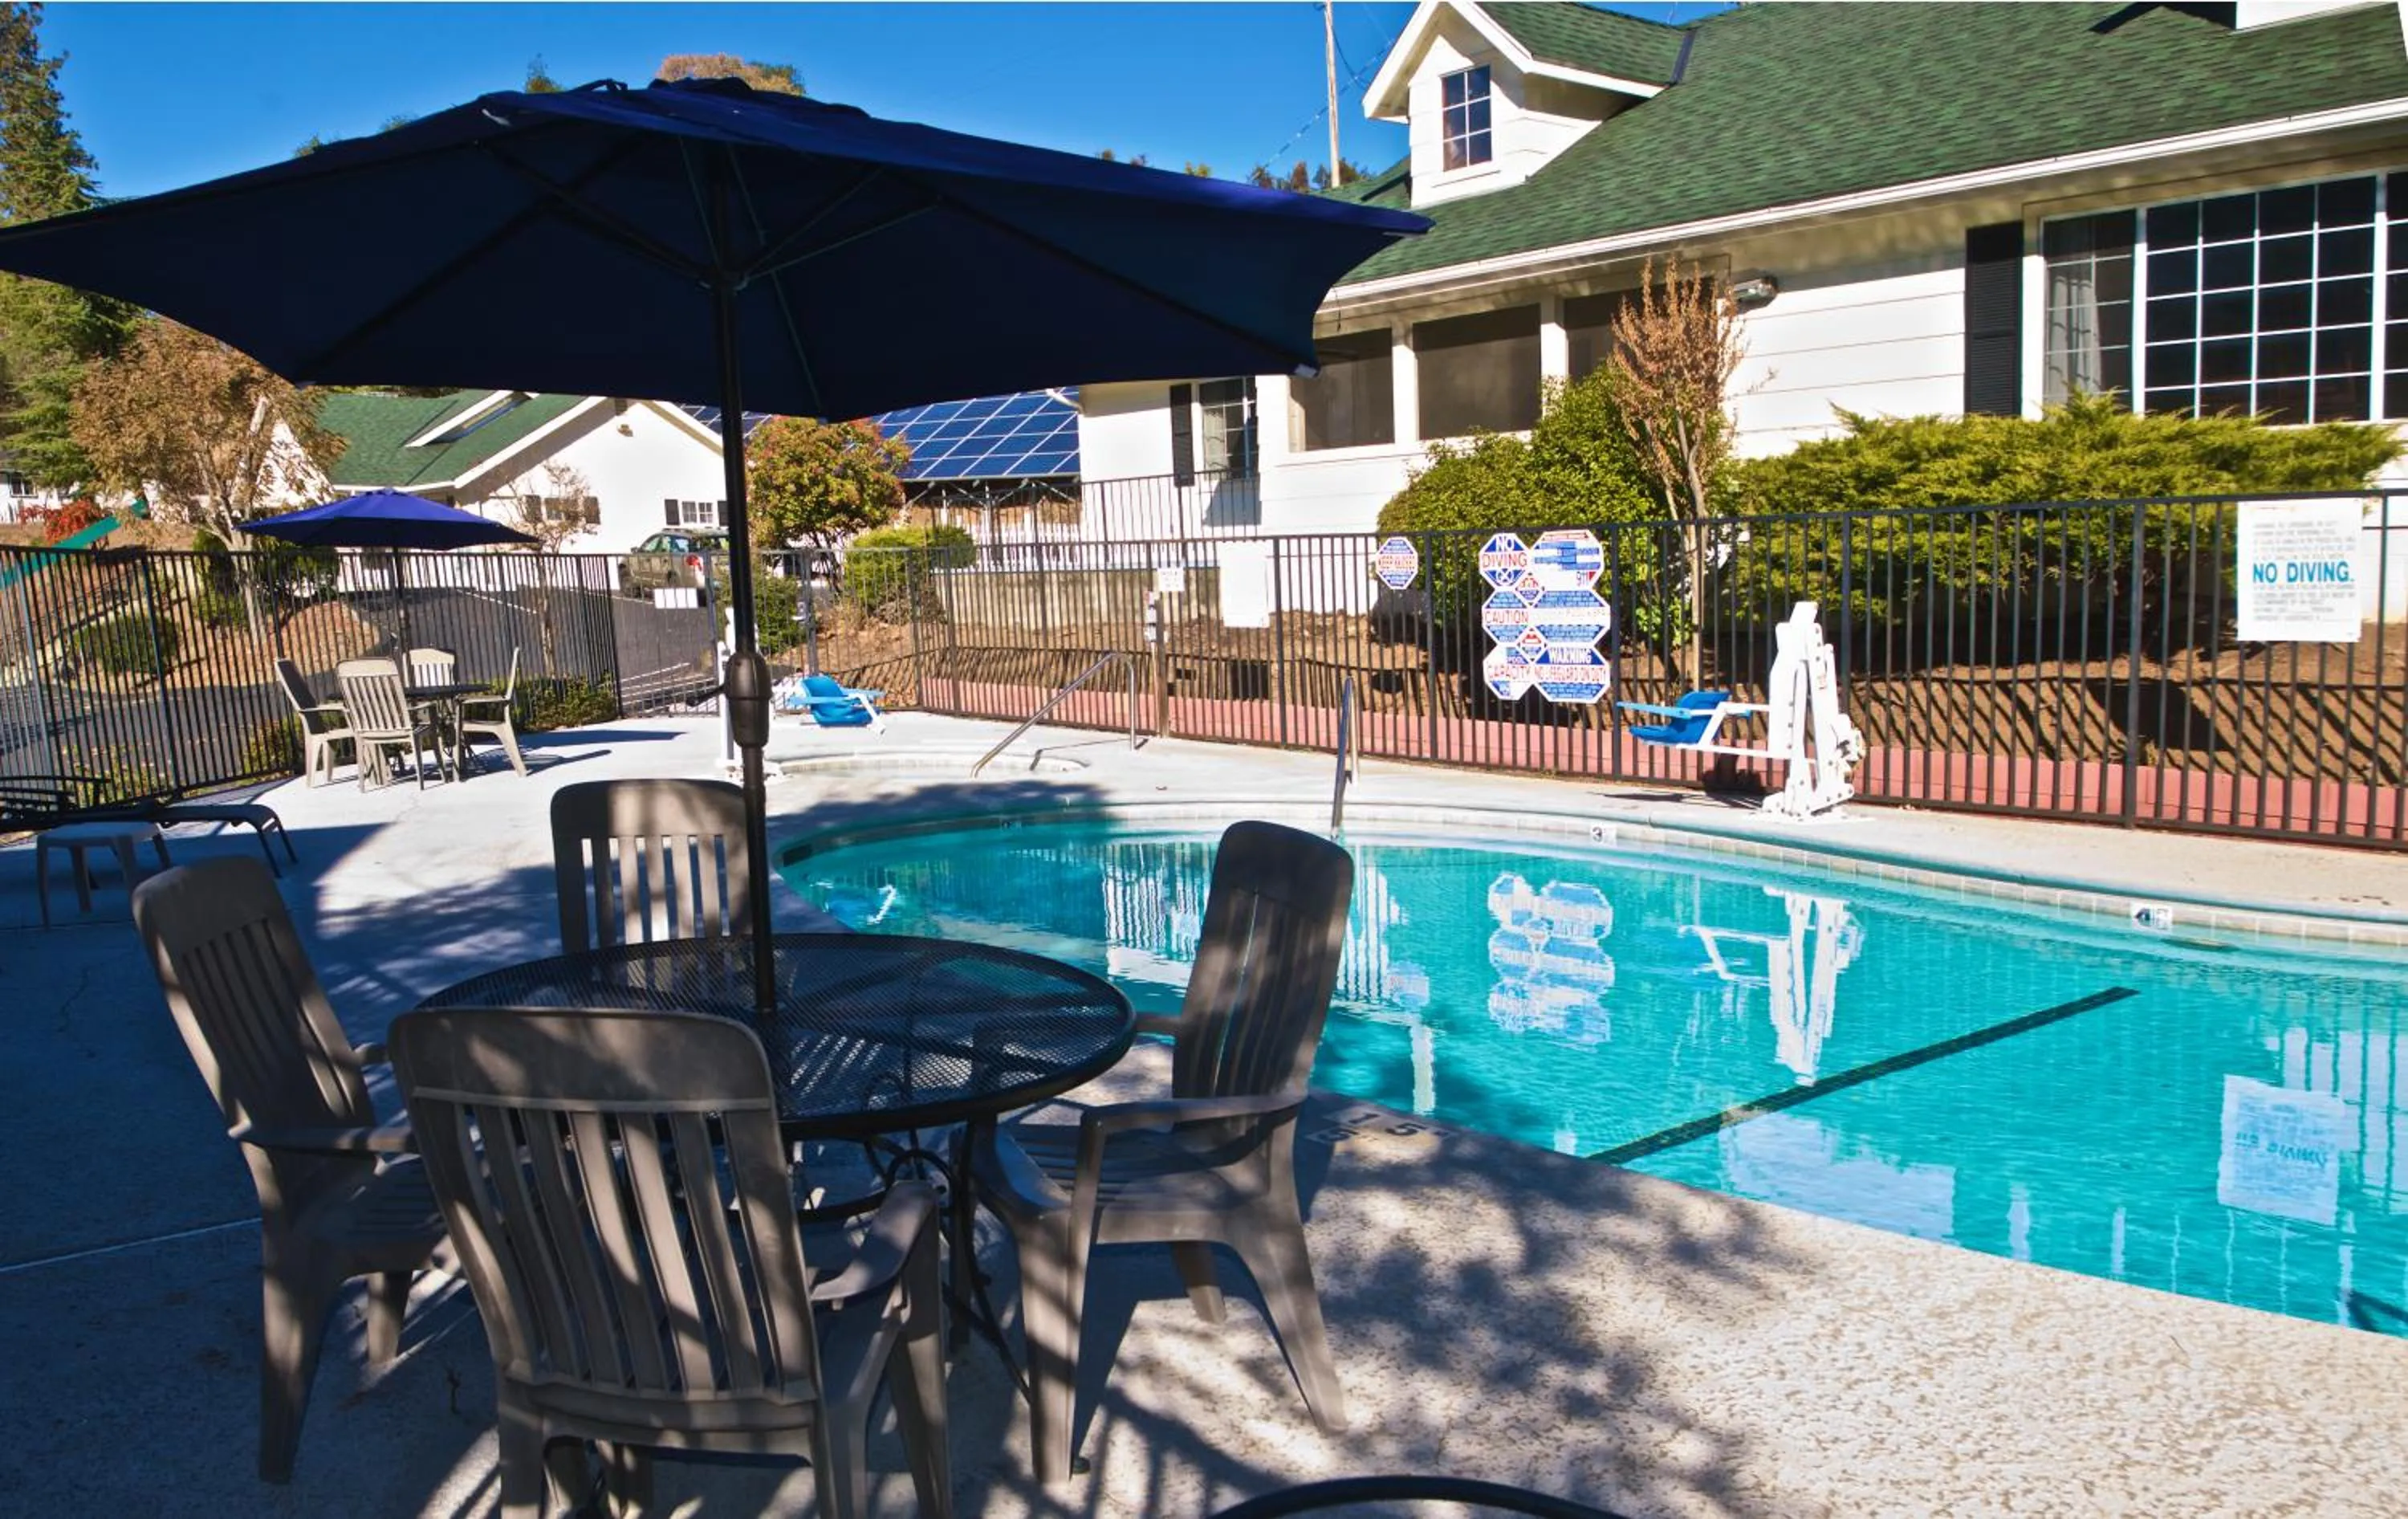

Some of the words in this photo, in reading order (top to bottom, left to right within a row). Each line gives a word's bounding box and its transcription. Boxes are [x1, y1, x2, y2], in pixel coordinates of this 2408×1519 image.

[1496, 535, 1515, 552] NO
[1483, 552, 1527, 568] DIVING
[2252, 562, 2278, 583] NO
[2286, 560, 2355, 583] DIVING.
[1485, 610, 1529, 624] CAUTION
[1550, 647, 1592, 664] WARNING
[1487, 665, 1531, 680] CAPACITY
